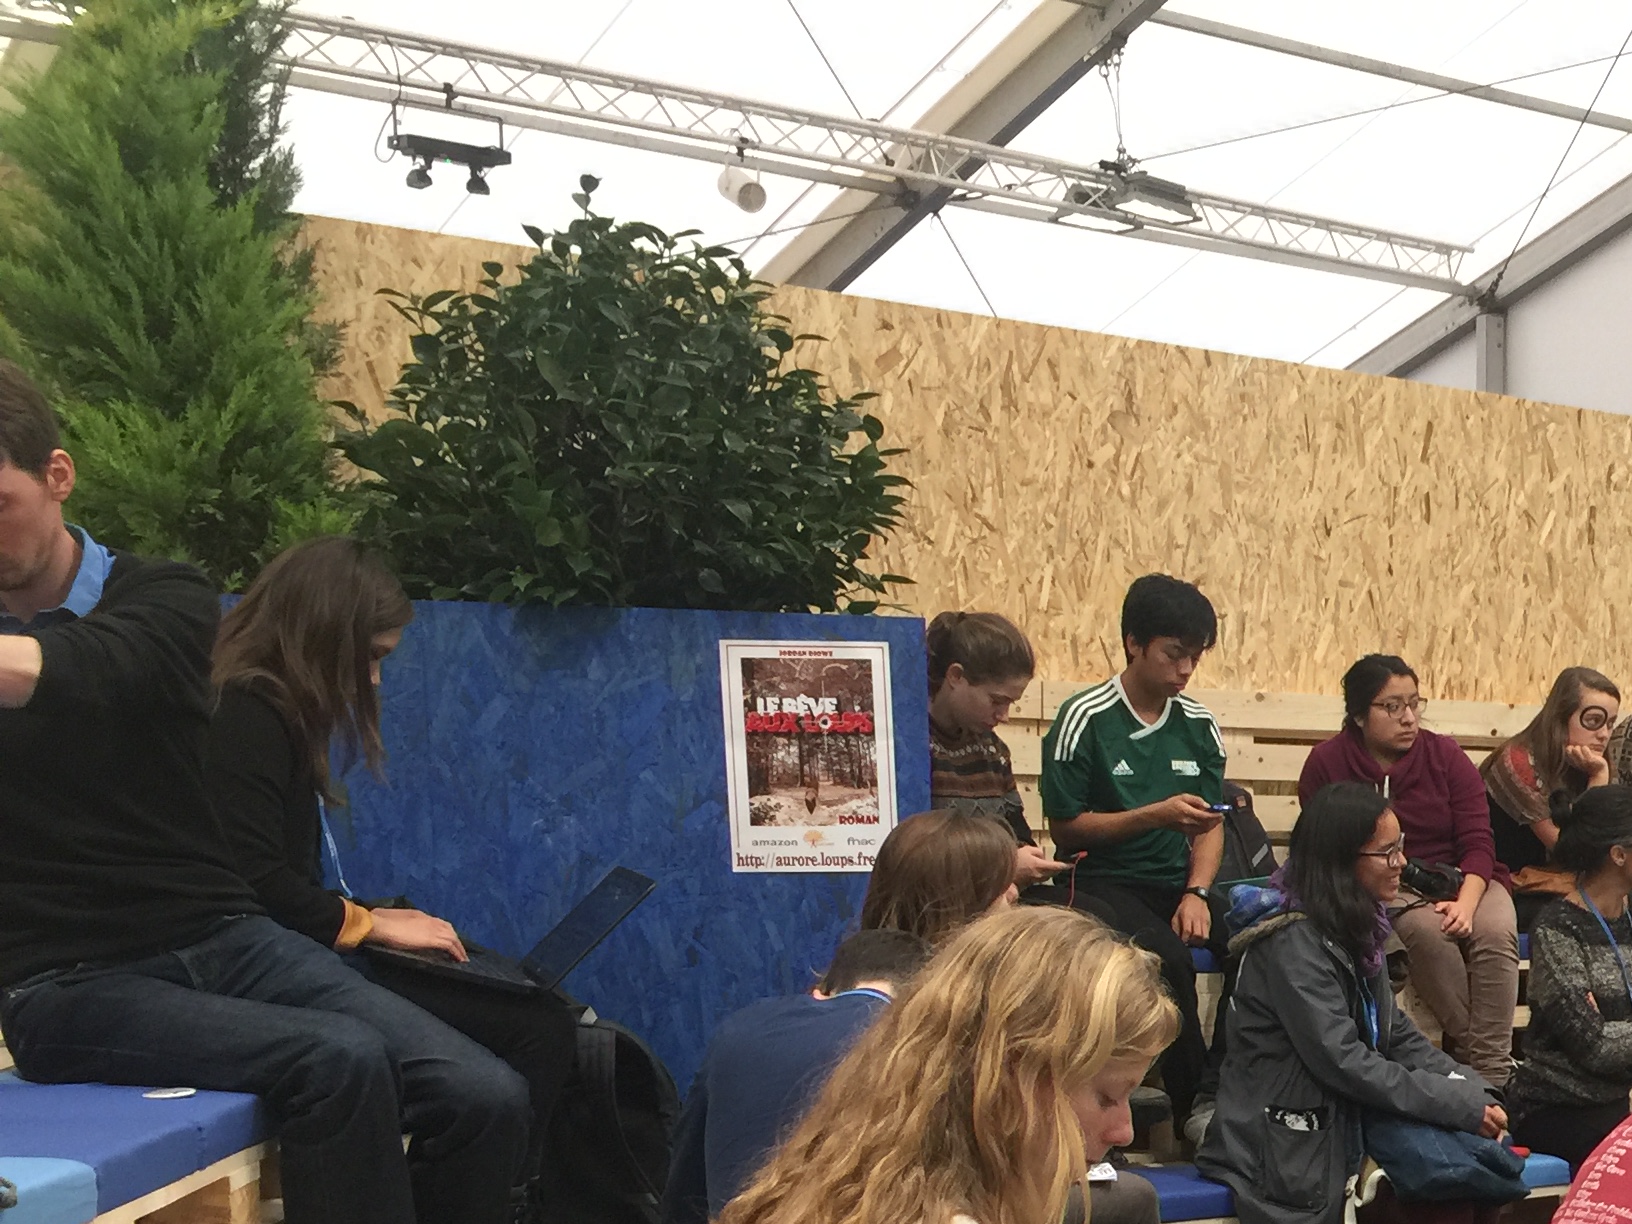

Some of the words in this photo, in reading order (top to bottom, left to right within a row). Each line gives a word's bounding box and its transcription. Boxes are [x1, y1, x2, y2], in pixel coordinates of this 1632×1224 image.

[756, 697, 780, 716] LE
[782, 693, 838, 717] RÊVE
[746, 712, 800, 733] AUX
[804, 712, 873, 733] LOUPS
[838, 815, 880, 825] ROMAN
[752, 838, 799, 846] amazon
[846, 836, 876, 846] fnac
